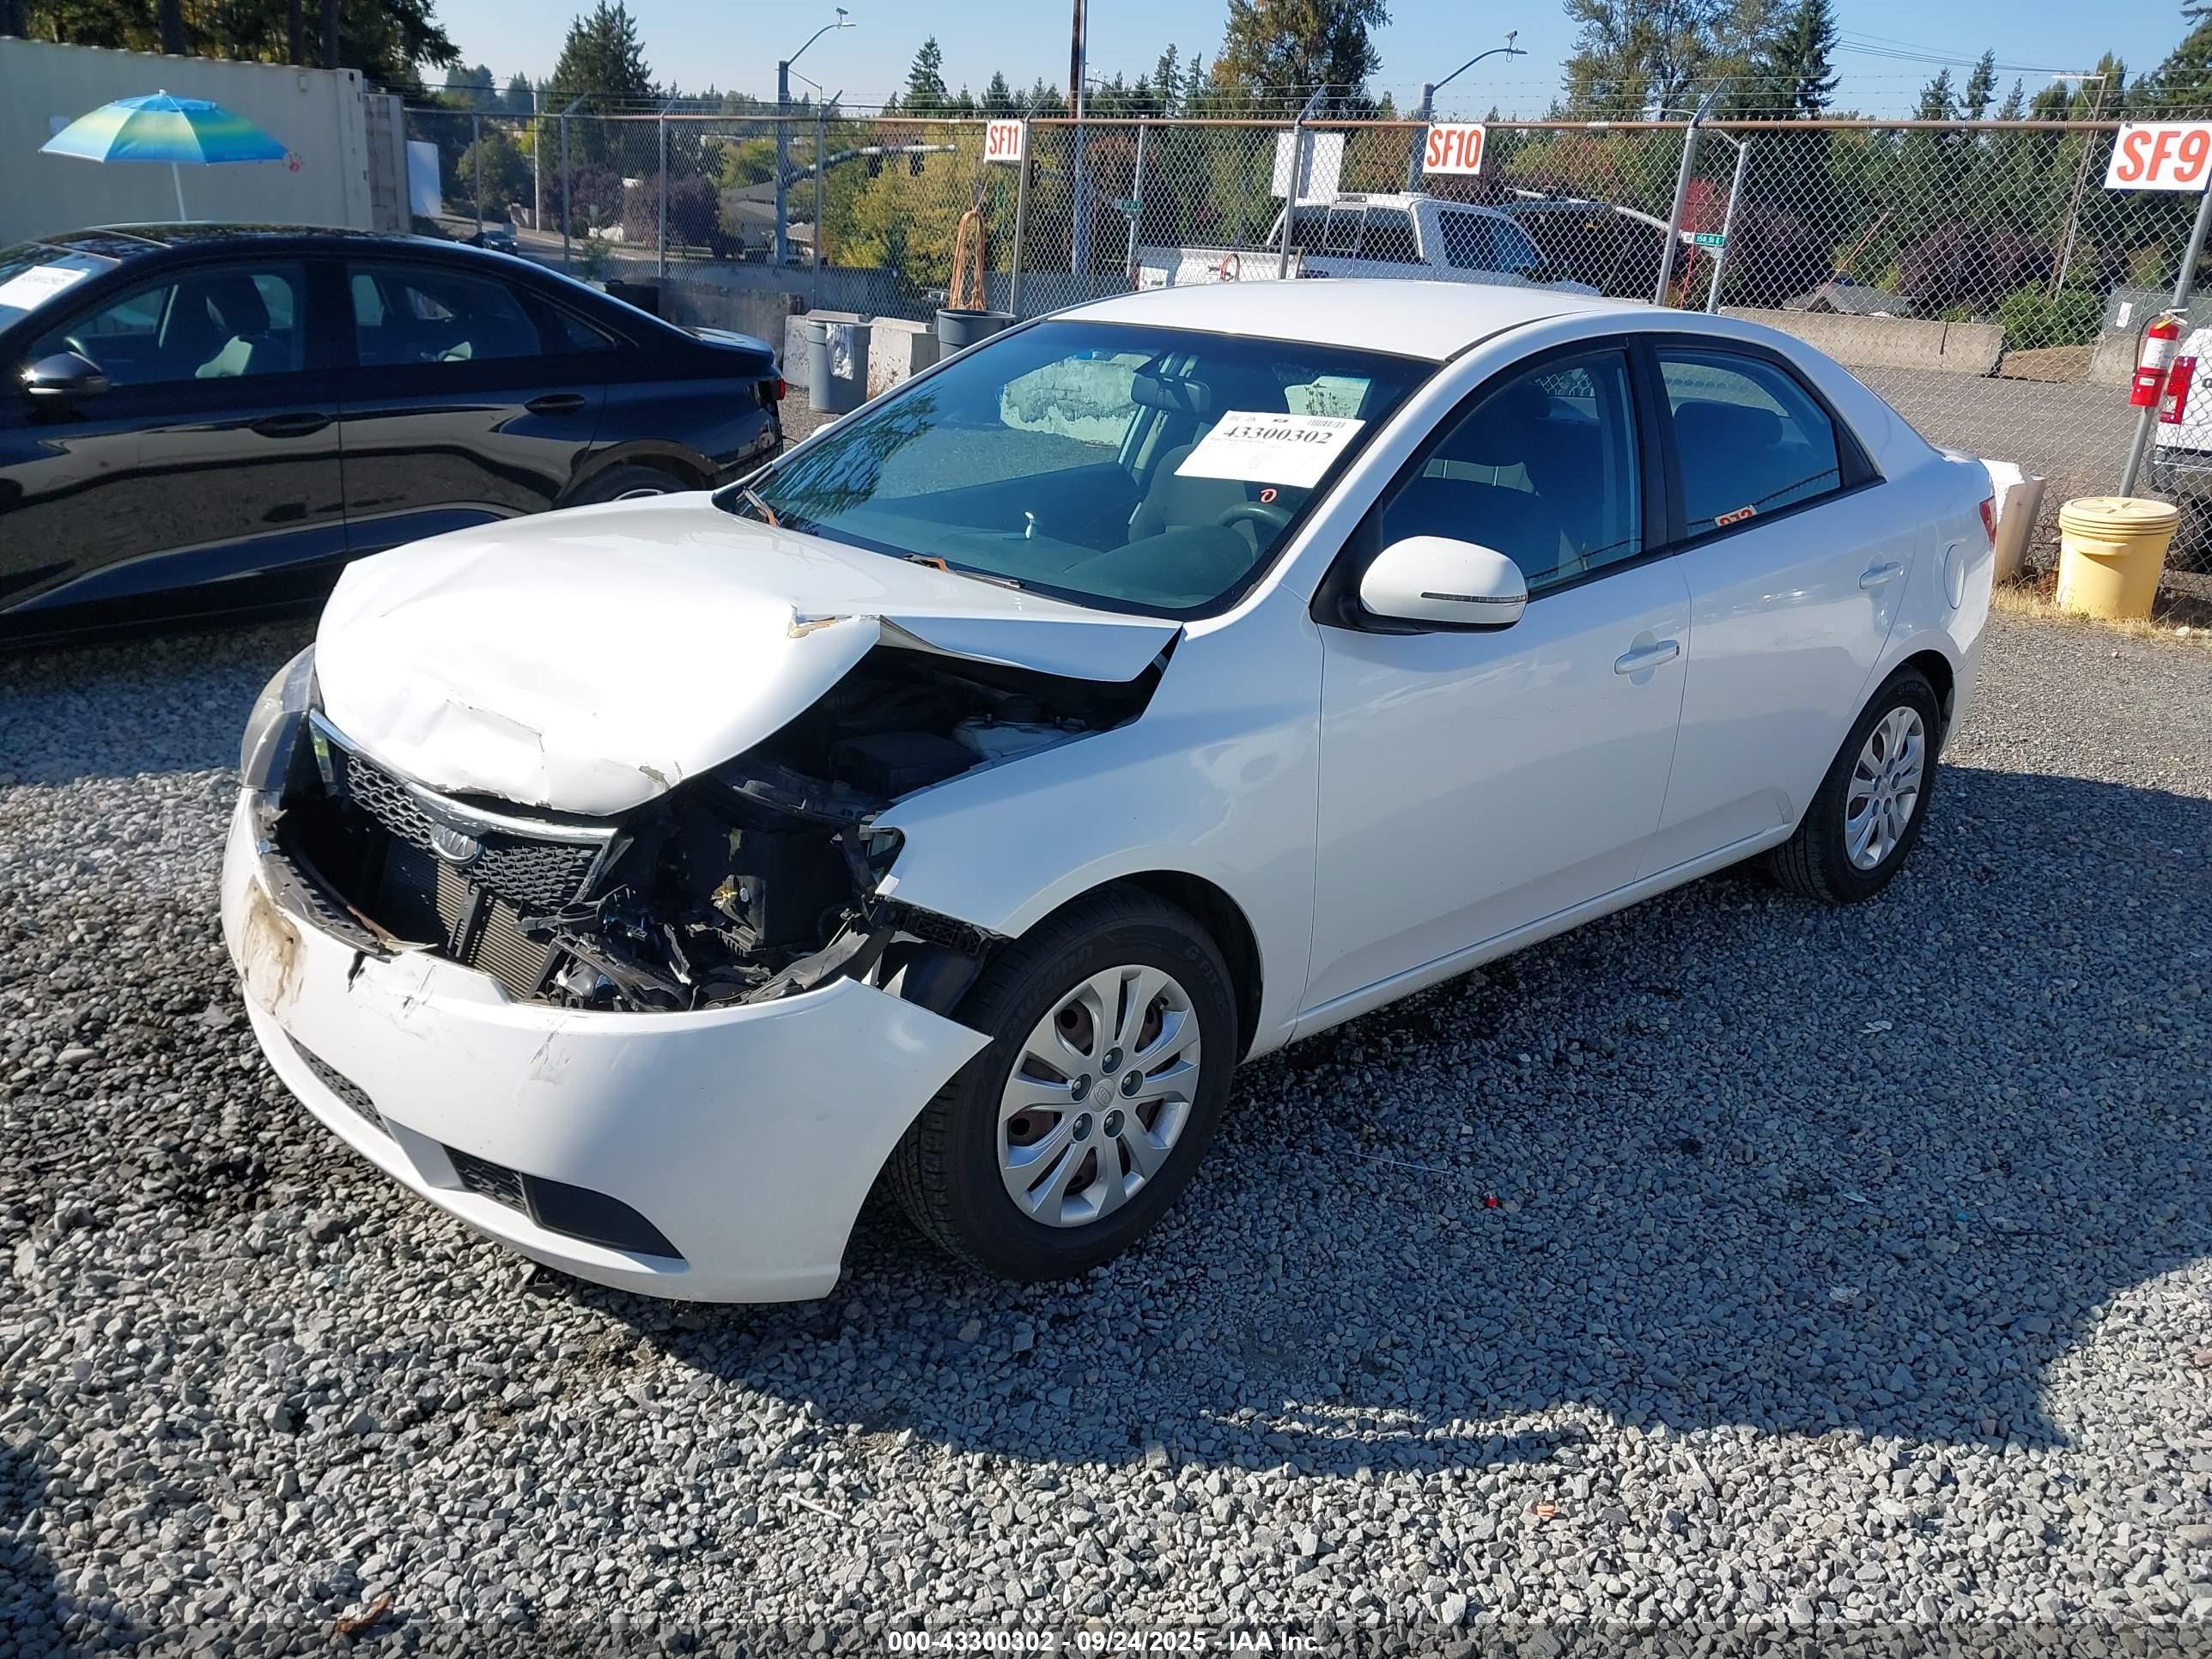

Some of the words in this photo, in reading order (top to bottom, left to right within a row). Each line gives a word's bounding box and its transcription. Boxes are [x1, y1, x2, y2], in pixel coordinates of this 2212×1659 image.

[989, 125, 1018, 155] SF11
[1426, 129, 1482, 168] SF10
[2116, 129, 2211, 183] SF9
[1223, 425, 1334, 445] 43300302
